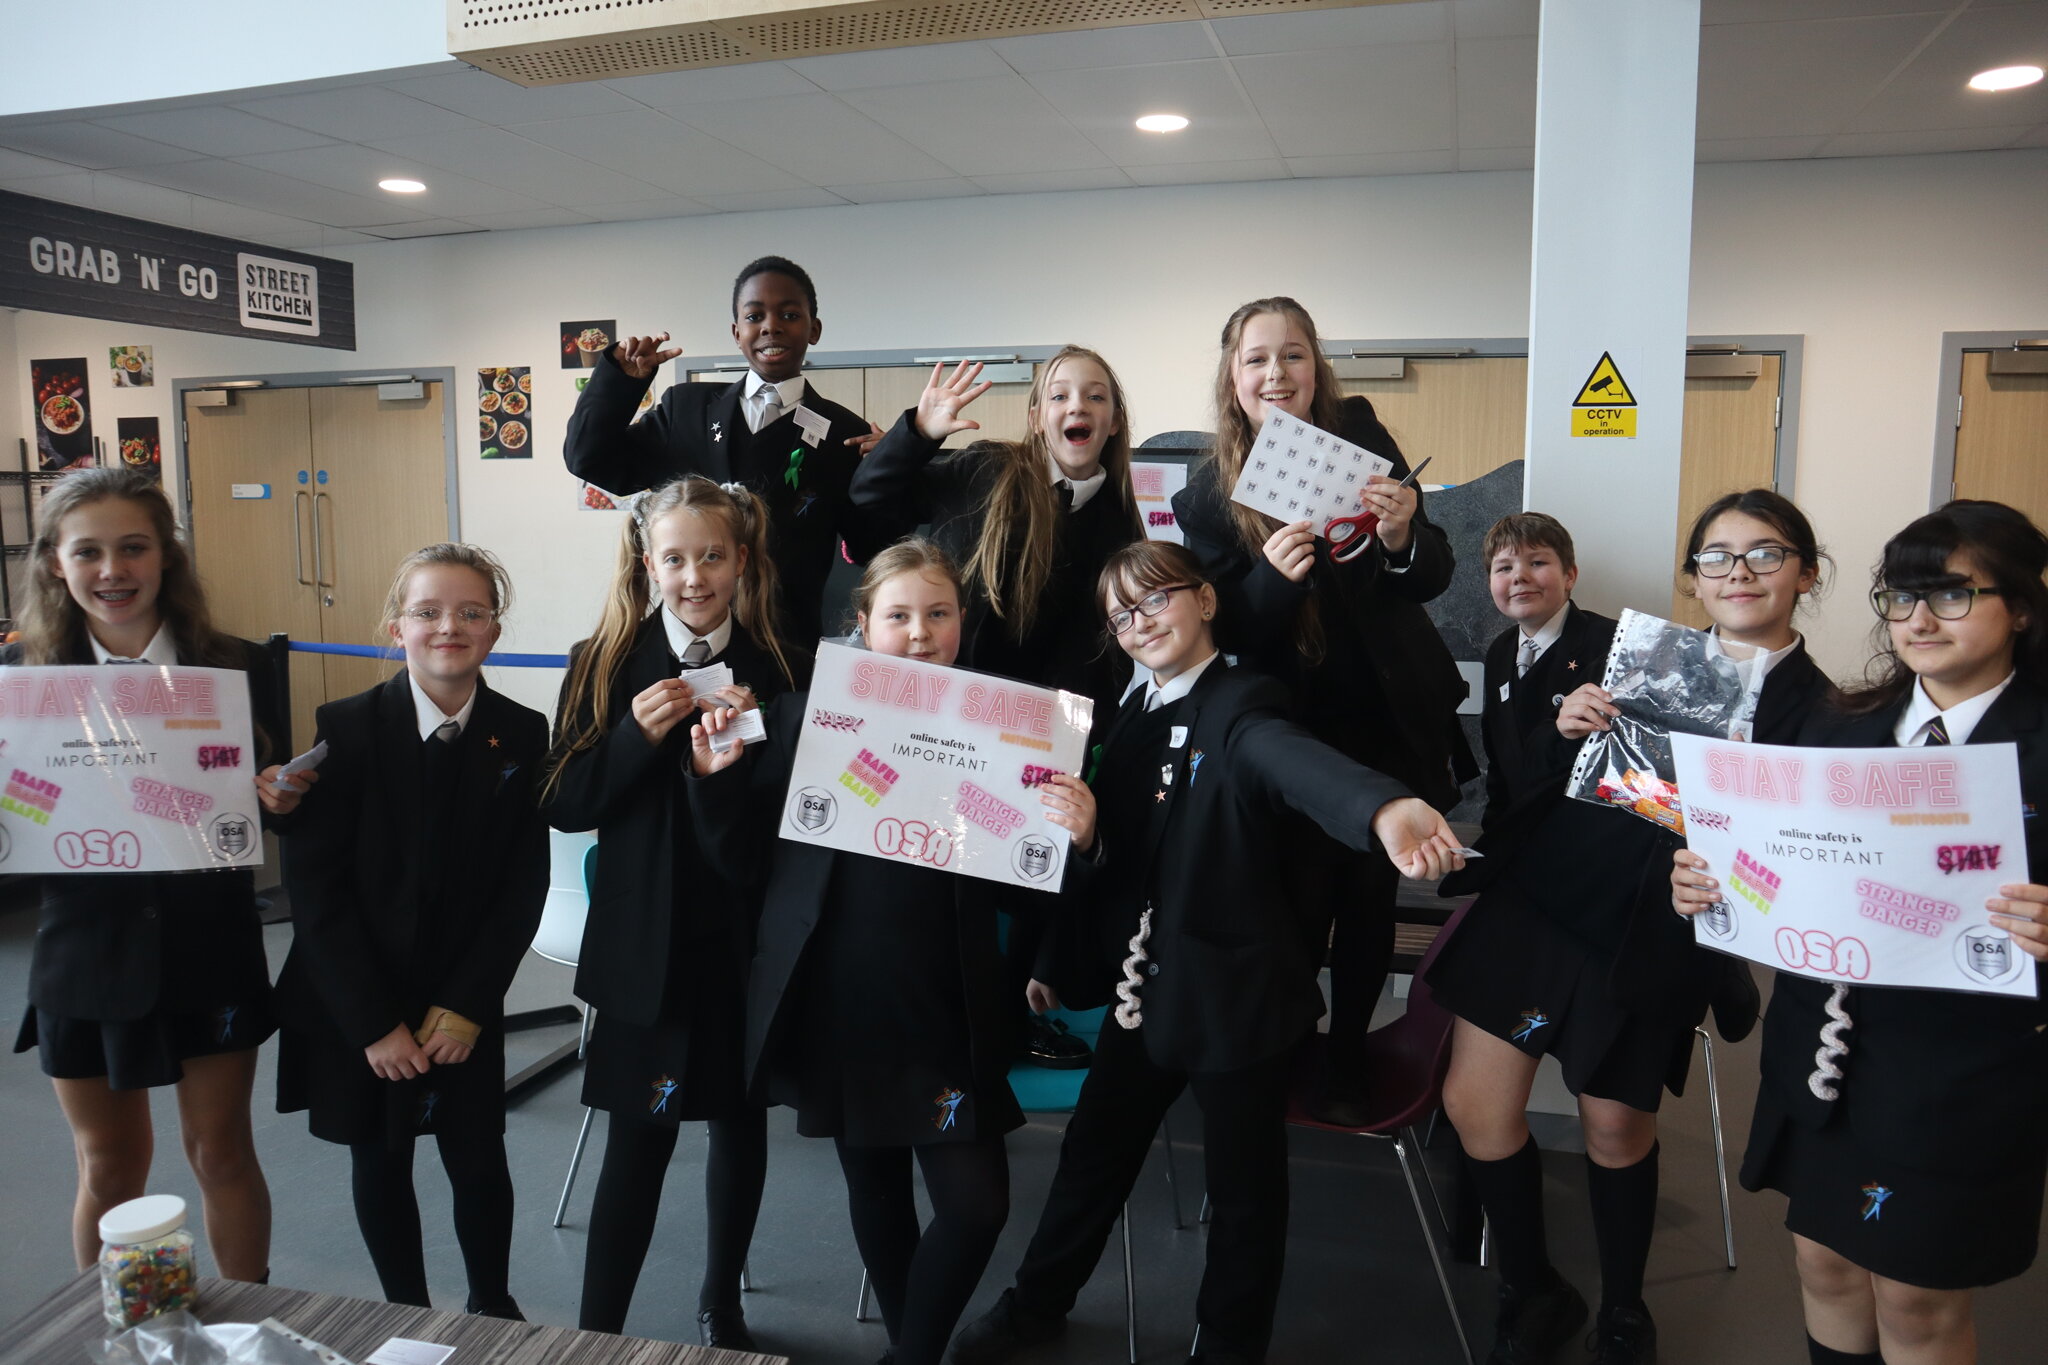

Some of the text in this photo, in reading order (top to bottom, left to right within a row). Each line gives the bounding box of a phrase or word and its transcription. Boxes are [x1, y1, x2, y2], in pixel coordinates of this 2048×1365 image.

[29, 236, 121, 284] GRAB
[178, 263, 218, 300] GO
[246, 264, 310, 296] STREET
[247, 290, 312, 316] KITCHEN
[1587, 409, 1622, 419] CCTV
[1583, 428, 1624, 436] operation
[1133, 469, 1163, 493] FE
[113, 676, 216, 715] SAFE
[851, 662, 1054, 736] STAY SAFE
[812, 708, 864, 734] HAPPY
[892, 742, 988, 772] IMPORTANT
[910, 732, 976, 752] online safety is
[45, 752, 157, 768] IMPORTANT
[1021, 764, 1067, 789] STA
[1706, 750, 1959, 807] STAY SAFE
[131, 778, 214, 811] STRANGER
[803, 800, 826, 812] OSA
[958, 780, 1026, 829] STRANGER
[134, 796, 201, 827] DANGER
[956, 799, 1011, 840] DANGER
[221, 827, 244, 836] OSA
[874, 817, 953, 867] OSA
[1779, 829, 1862, 844] online safety is
[54, 829, 141, 868] OSA
[1025, 848, 1047, 860] OSA
[1765, 842, 1884, 865] IMPORTANT
[1936, 845, 2001, 875] STAY
[1709, 906, 1728, 917] OSA
[1857, 879, 1960, 921] STRANGER
[1860, 901, 1942, 937] DANGER
[1775, 927, 1870, 980] OSA
[1973, 943, 2005, 955] OSA
